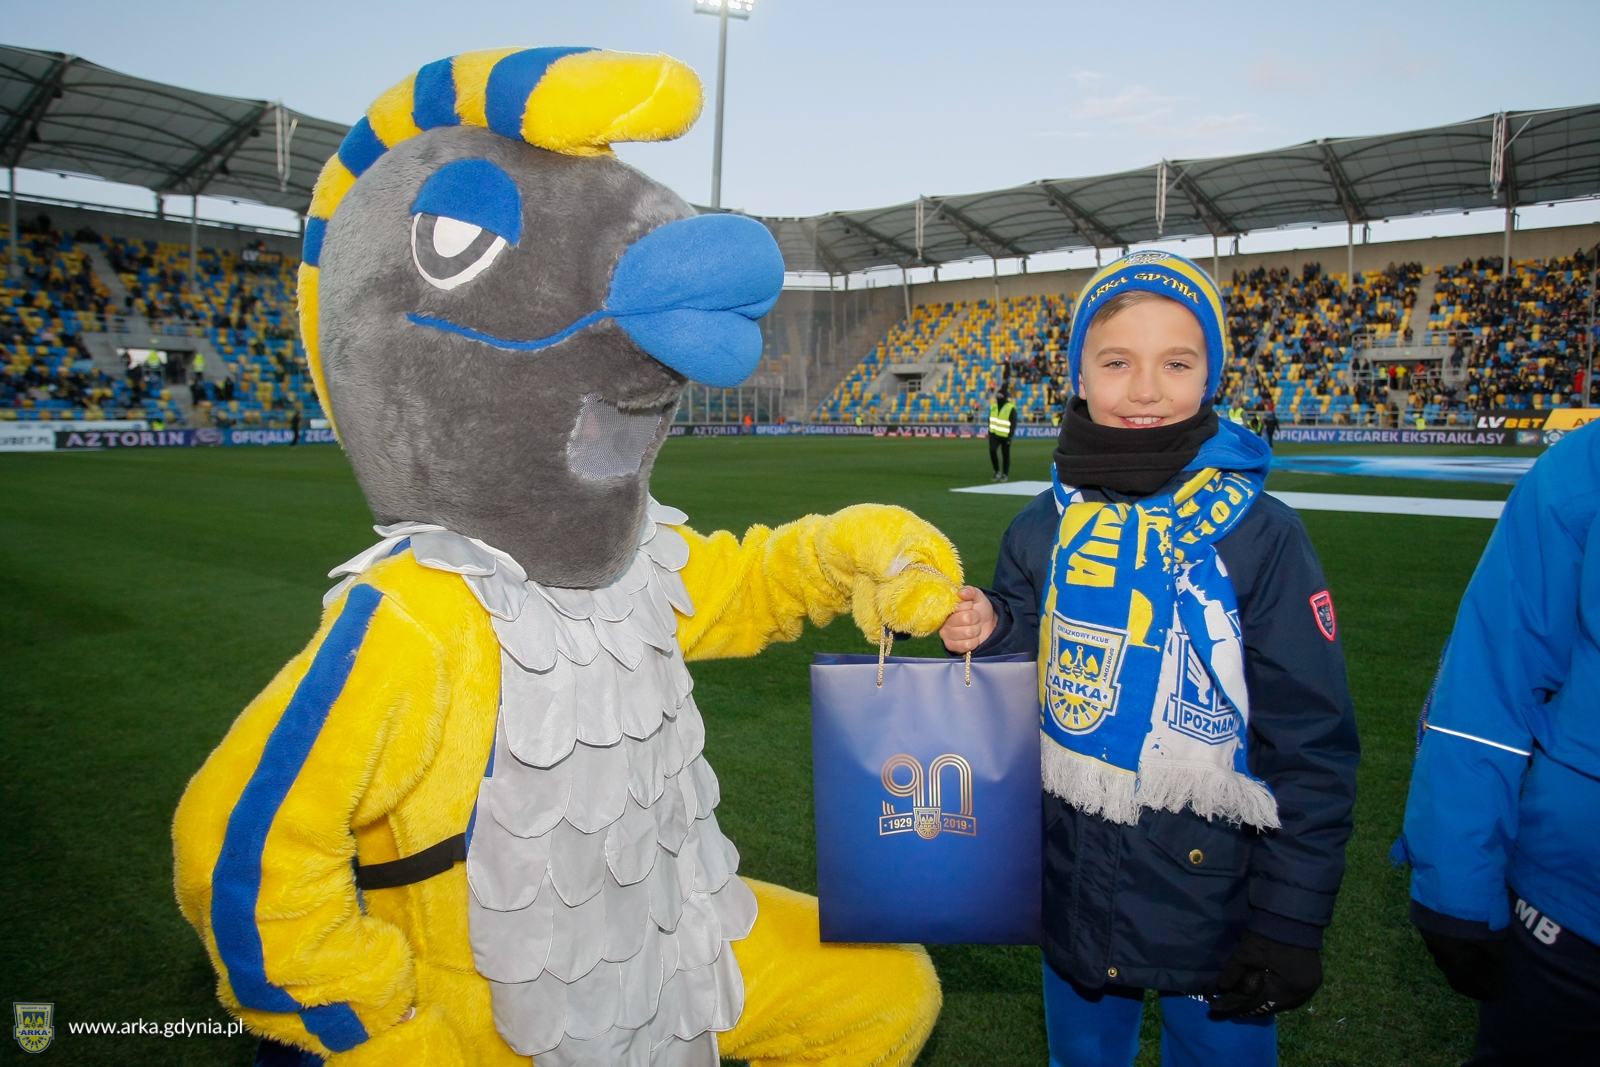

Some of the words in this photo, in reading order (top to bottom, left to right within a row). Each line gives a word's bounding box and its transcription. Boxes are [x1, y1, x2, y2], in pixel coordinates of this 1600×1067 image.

[1134, 272, 1199, 304] GDYNIA
[692, 426, 738, 434] AZTORIN
[1272, 430, 1336, 442] OFICJALNY
[1338, 430, 1399, 443] ZEGAREK
[1402, 432, 1505, 445] EKSTRAKLASY
[65, 432, 184, 447] AZTORIN
[1091, 634, 1109, 644] KLUB
[1052, 675, 1101, 702] ARKA
[888, 817, 912, 829] 1929
[943, 818, 967, 829] 2019
